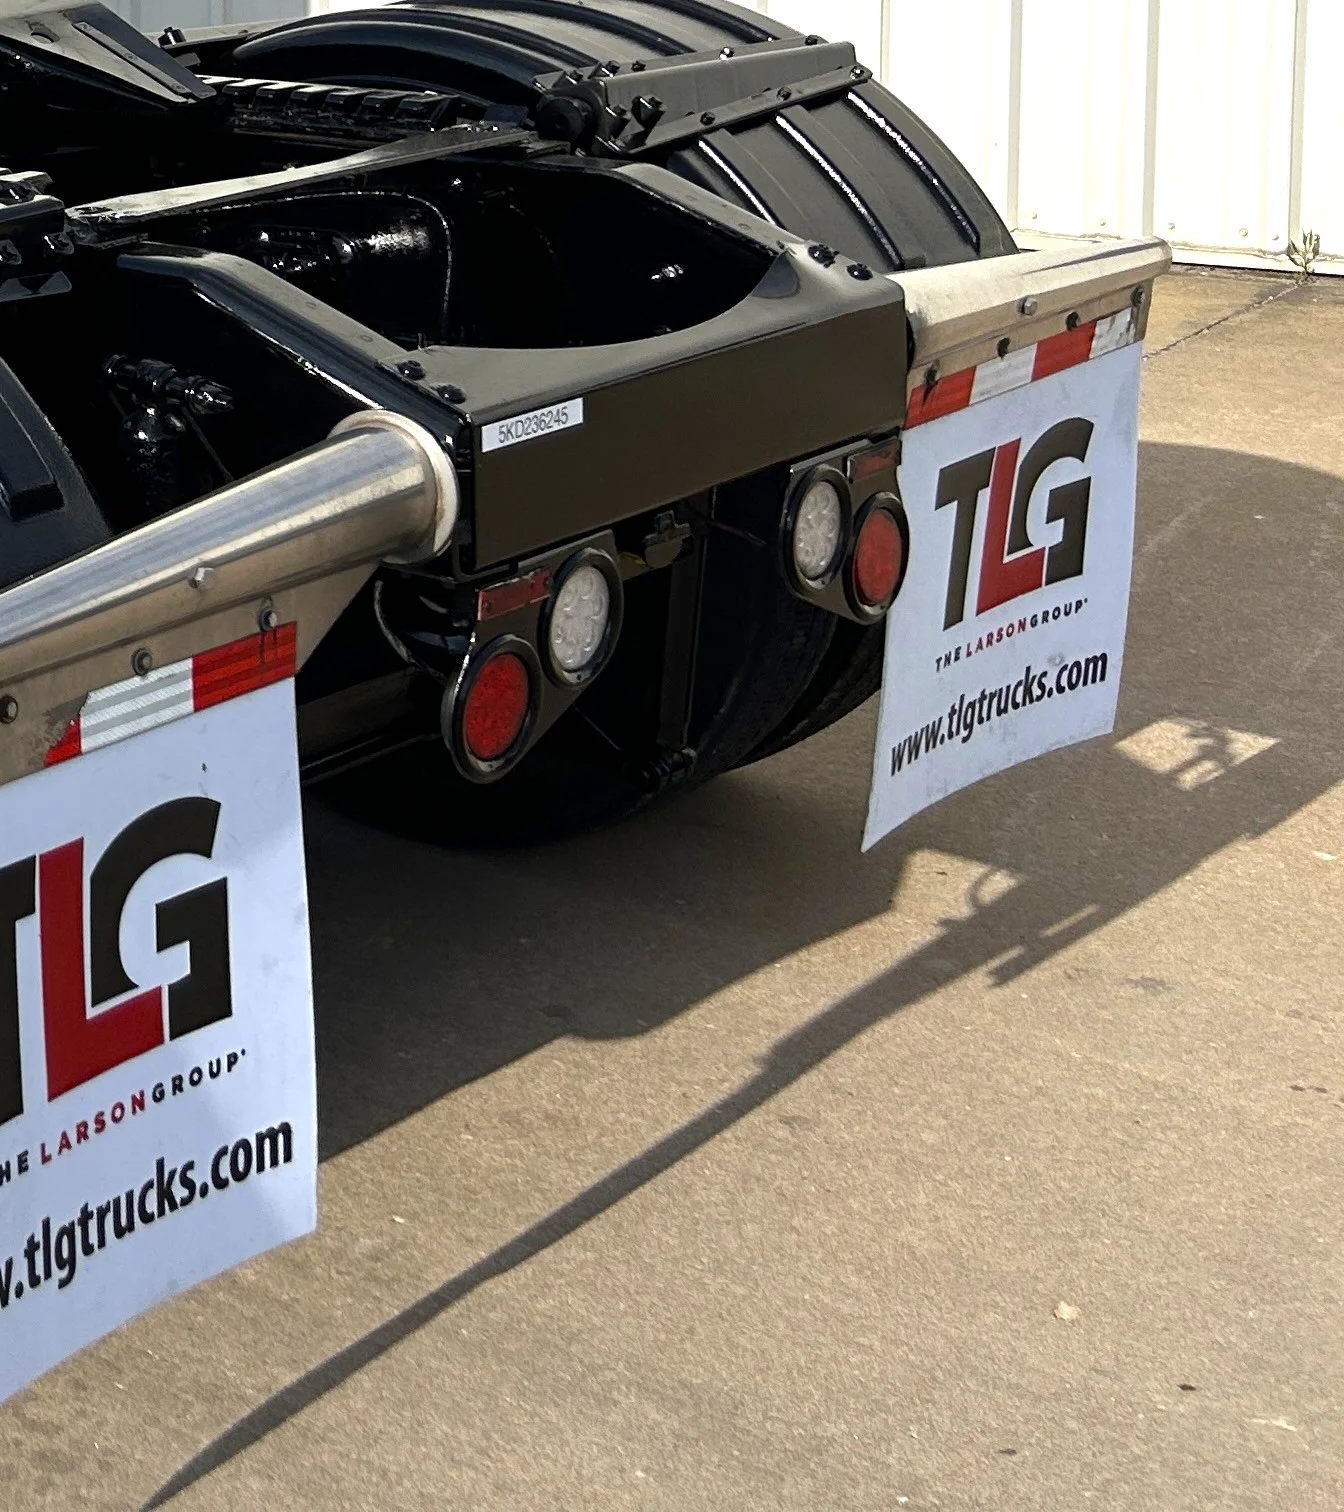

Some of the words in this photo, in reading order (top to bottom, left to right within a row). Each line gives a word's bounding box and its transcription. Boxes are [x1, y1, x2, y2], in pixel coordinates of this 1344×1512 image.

[498, 406, 569, 444] 5KD236245
[934, 416, 1095, 632] TLG
[935, 646, 962, 674] THE
[891, 652, 1108, 777] www.tlgtrucks.com
